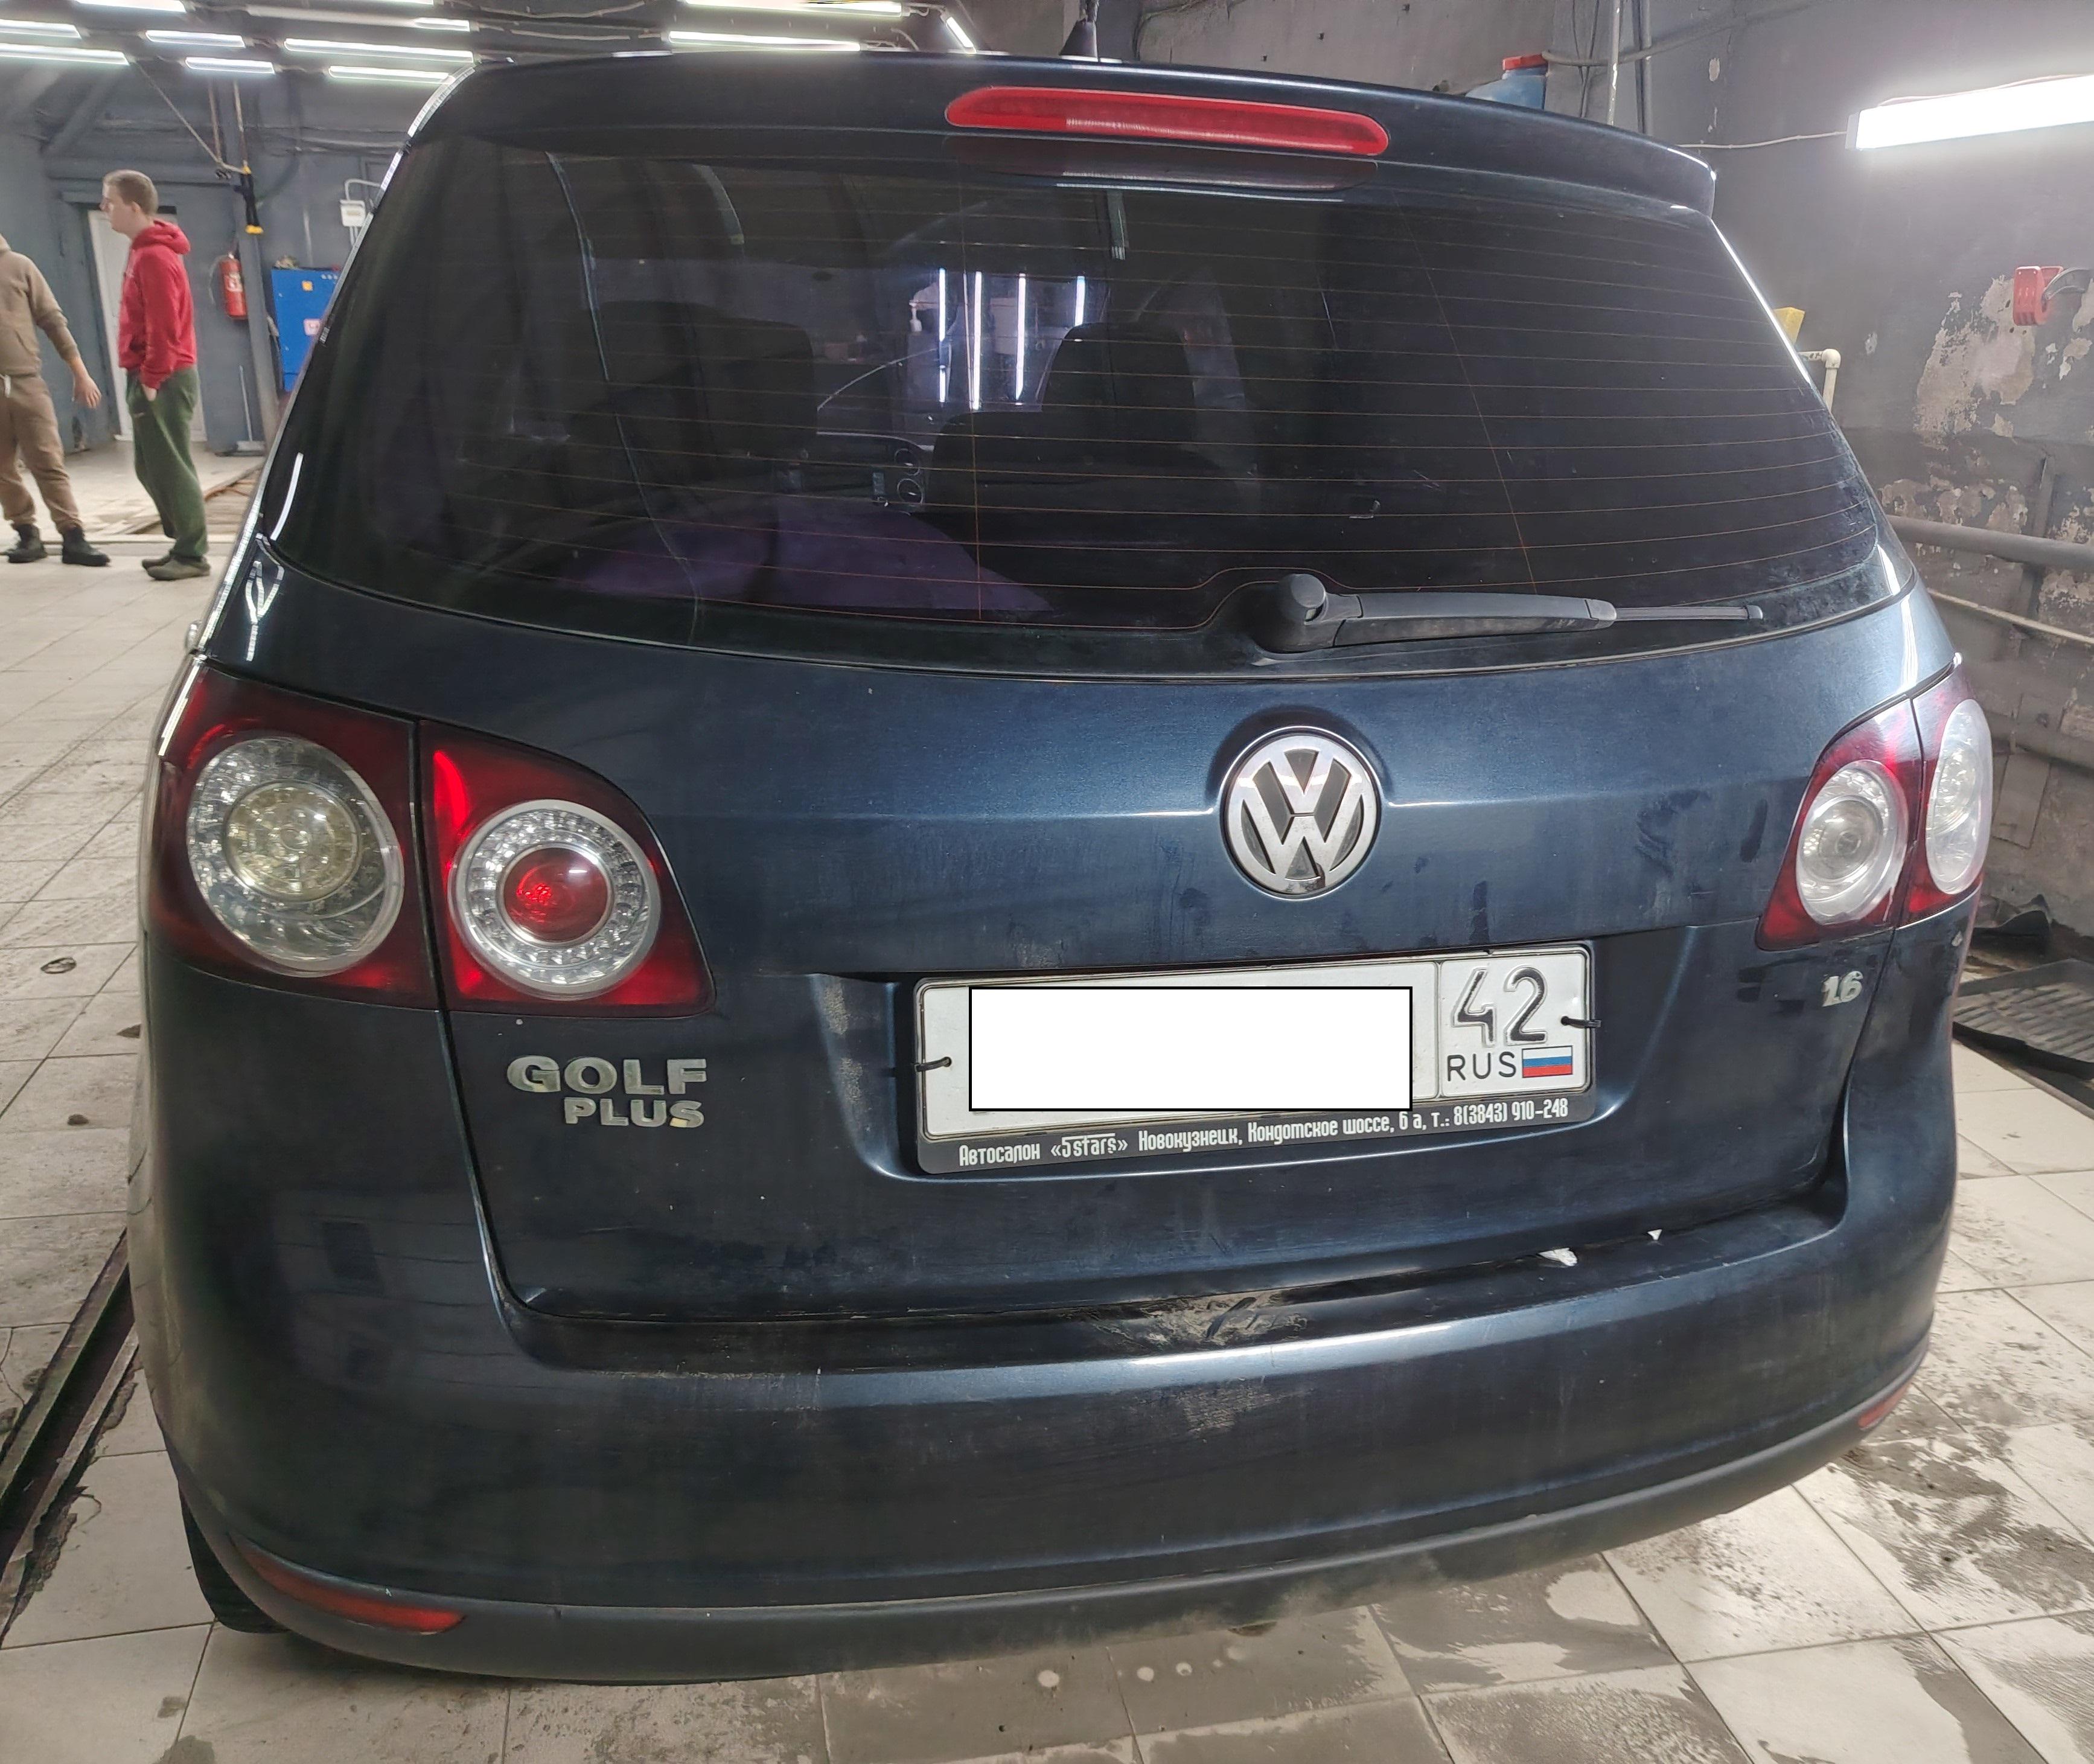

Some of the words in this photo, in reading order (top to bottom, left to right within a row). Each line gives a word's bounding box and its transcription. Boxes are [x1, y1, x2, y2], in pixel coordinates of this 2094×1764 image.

[1451, 965, 1548, 1047] 42
[506, 1055, 707, 1095] GOLF
[1448, 1051, 1516, 1081] RUS
[564, 1097, 704, 1128] PLUS
[959, 1143, 1041, 1166] Автосалон
[1138, 1128, 1243, 1152] Новокузнецк,
[1342, 1116, 1394, 1133] шоссе,
[1412, 1113, 1427, 1130] а,
[1454, 1102, 1508, 1126] 8(3843)
[1511, 1098, 1569, 1121] 910-248
